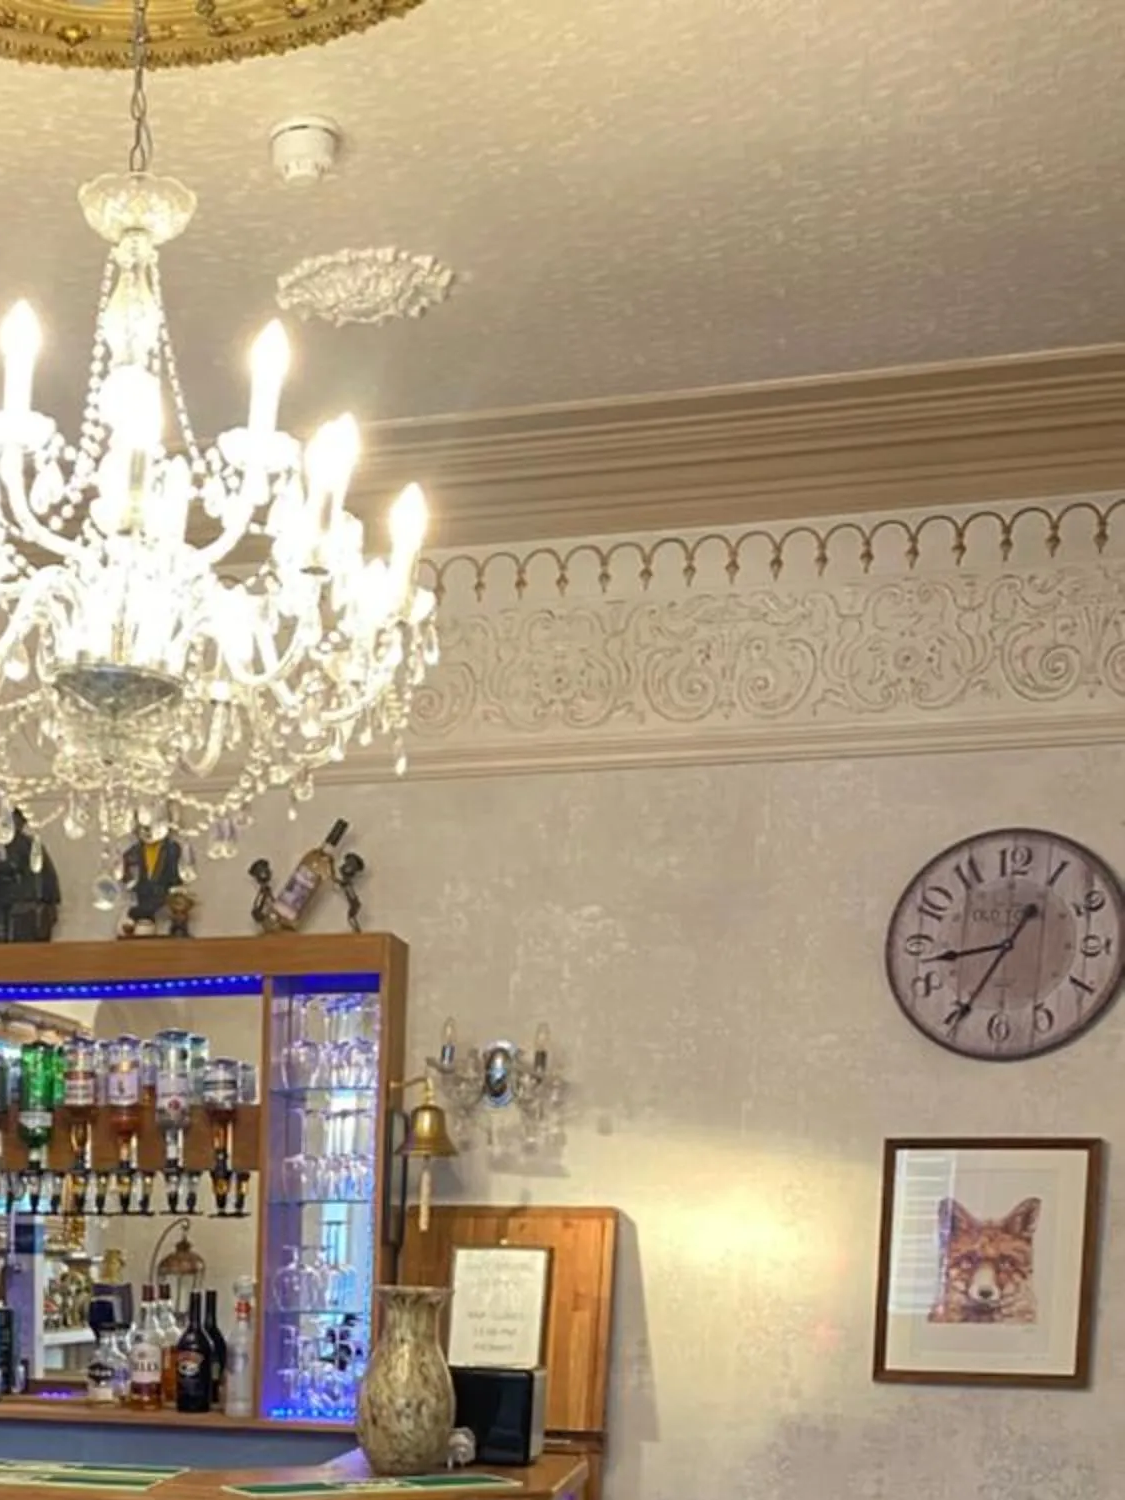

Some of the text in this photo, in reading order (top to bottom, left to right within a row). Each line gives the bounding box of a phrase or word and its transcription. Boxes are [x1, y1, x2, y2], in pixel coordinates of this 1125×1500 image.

[954, 855, 985, 891] 11
[997, 846, 1034, 878] 12
[1045, 860, 1070, 888] 1
[917, 885, 954, 923] 10
[1071, 890, 1106, 918] 2
[905, 932, 935, 958] 9
[1080, 933, 1113, 958] 3
[911, 969, 944, 999] 8
[986, 1012, 1011, 1043] 6
[1033, 1002, 1055, 1033] 5
